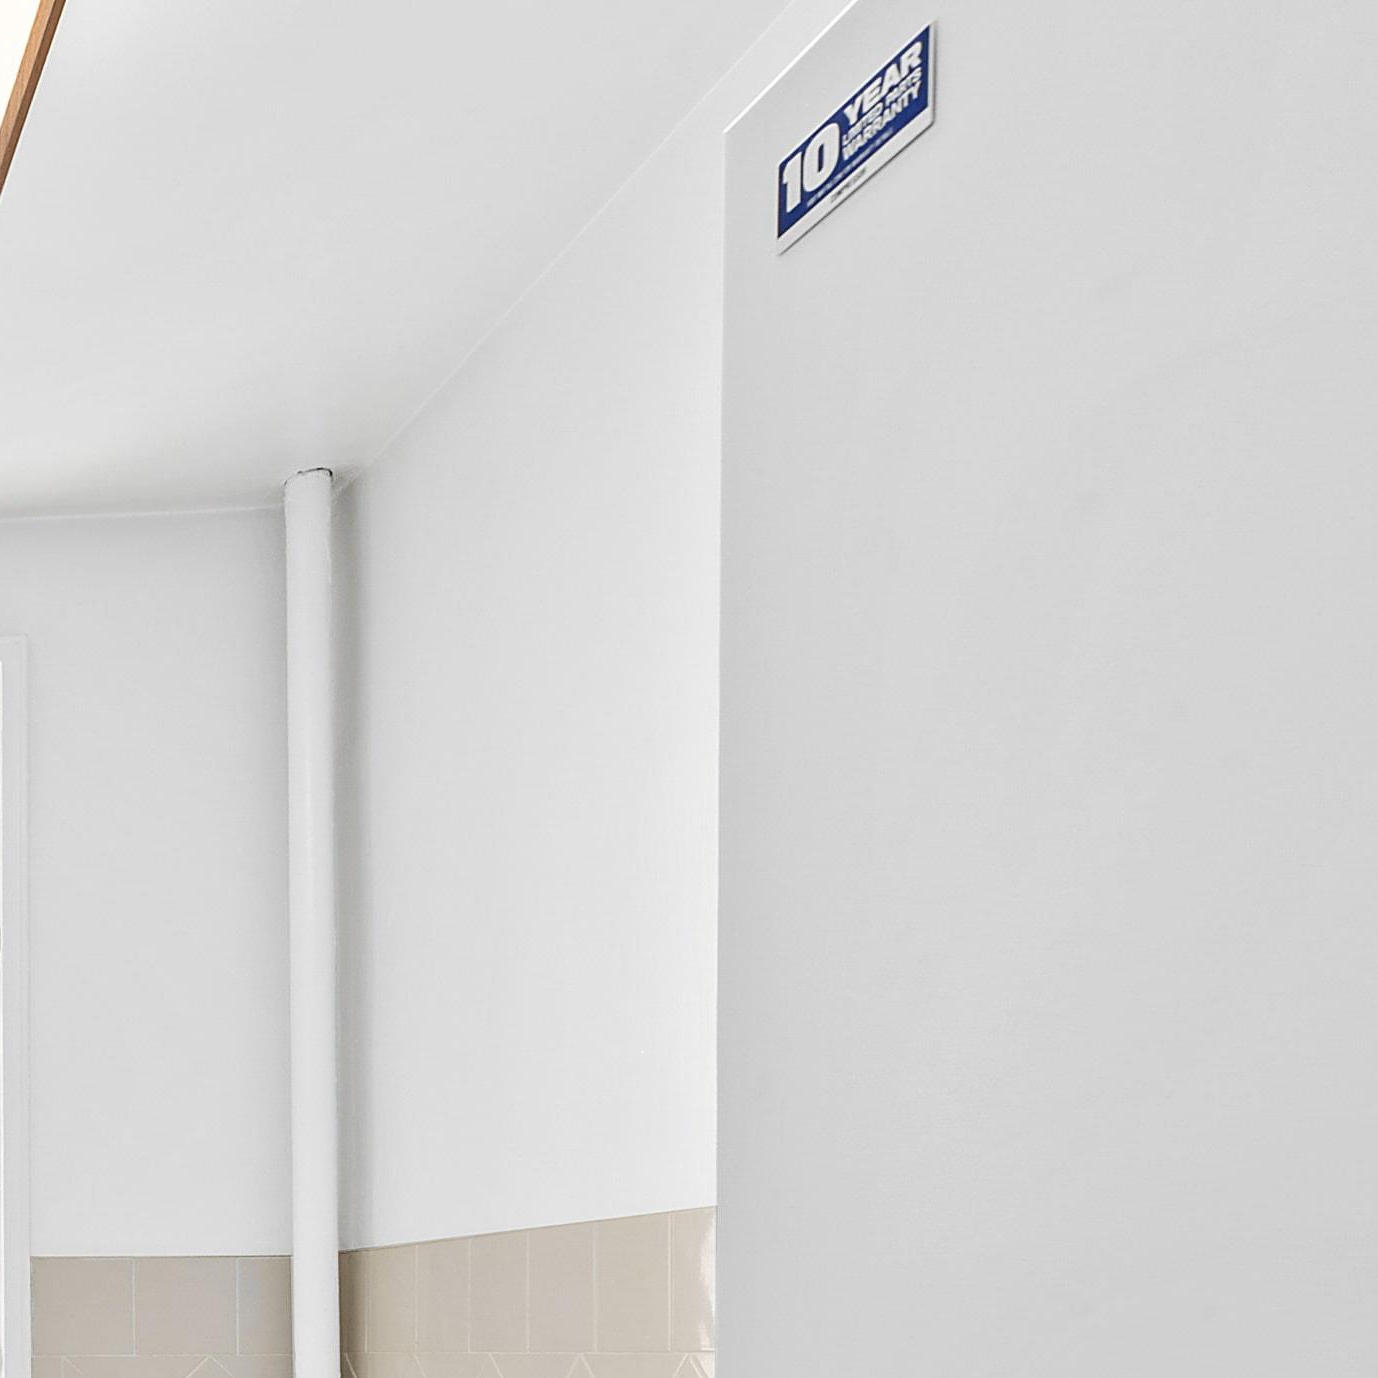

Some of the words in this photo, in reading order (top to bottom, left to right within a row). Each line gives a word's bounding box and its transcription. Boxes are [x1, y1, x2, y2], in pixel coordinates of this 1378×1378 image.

[782, 122, 841, 213] 10
[843, 41, 923, 125] YEAR
[842, 81, 922, 160] WARRANTY
